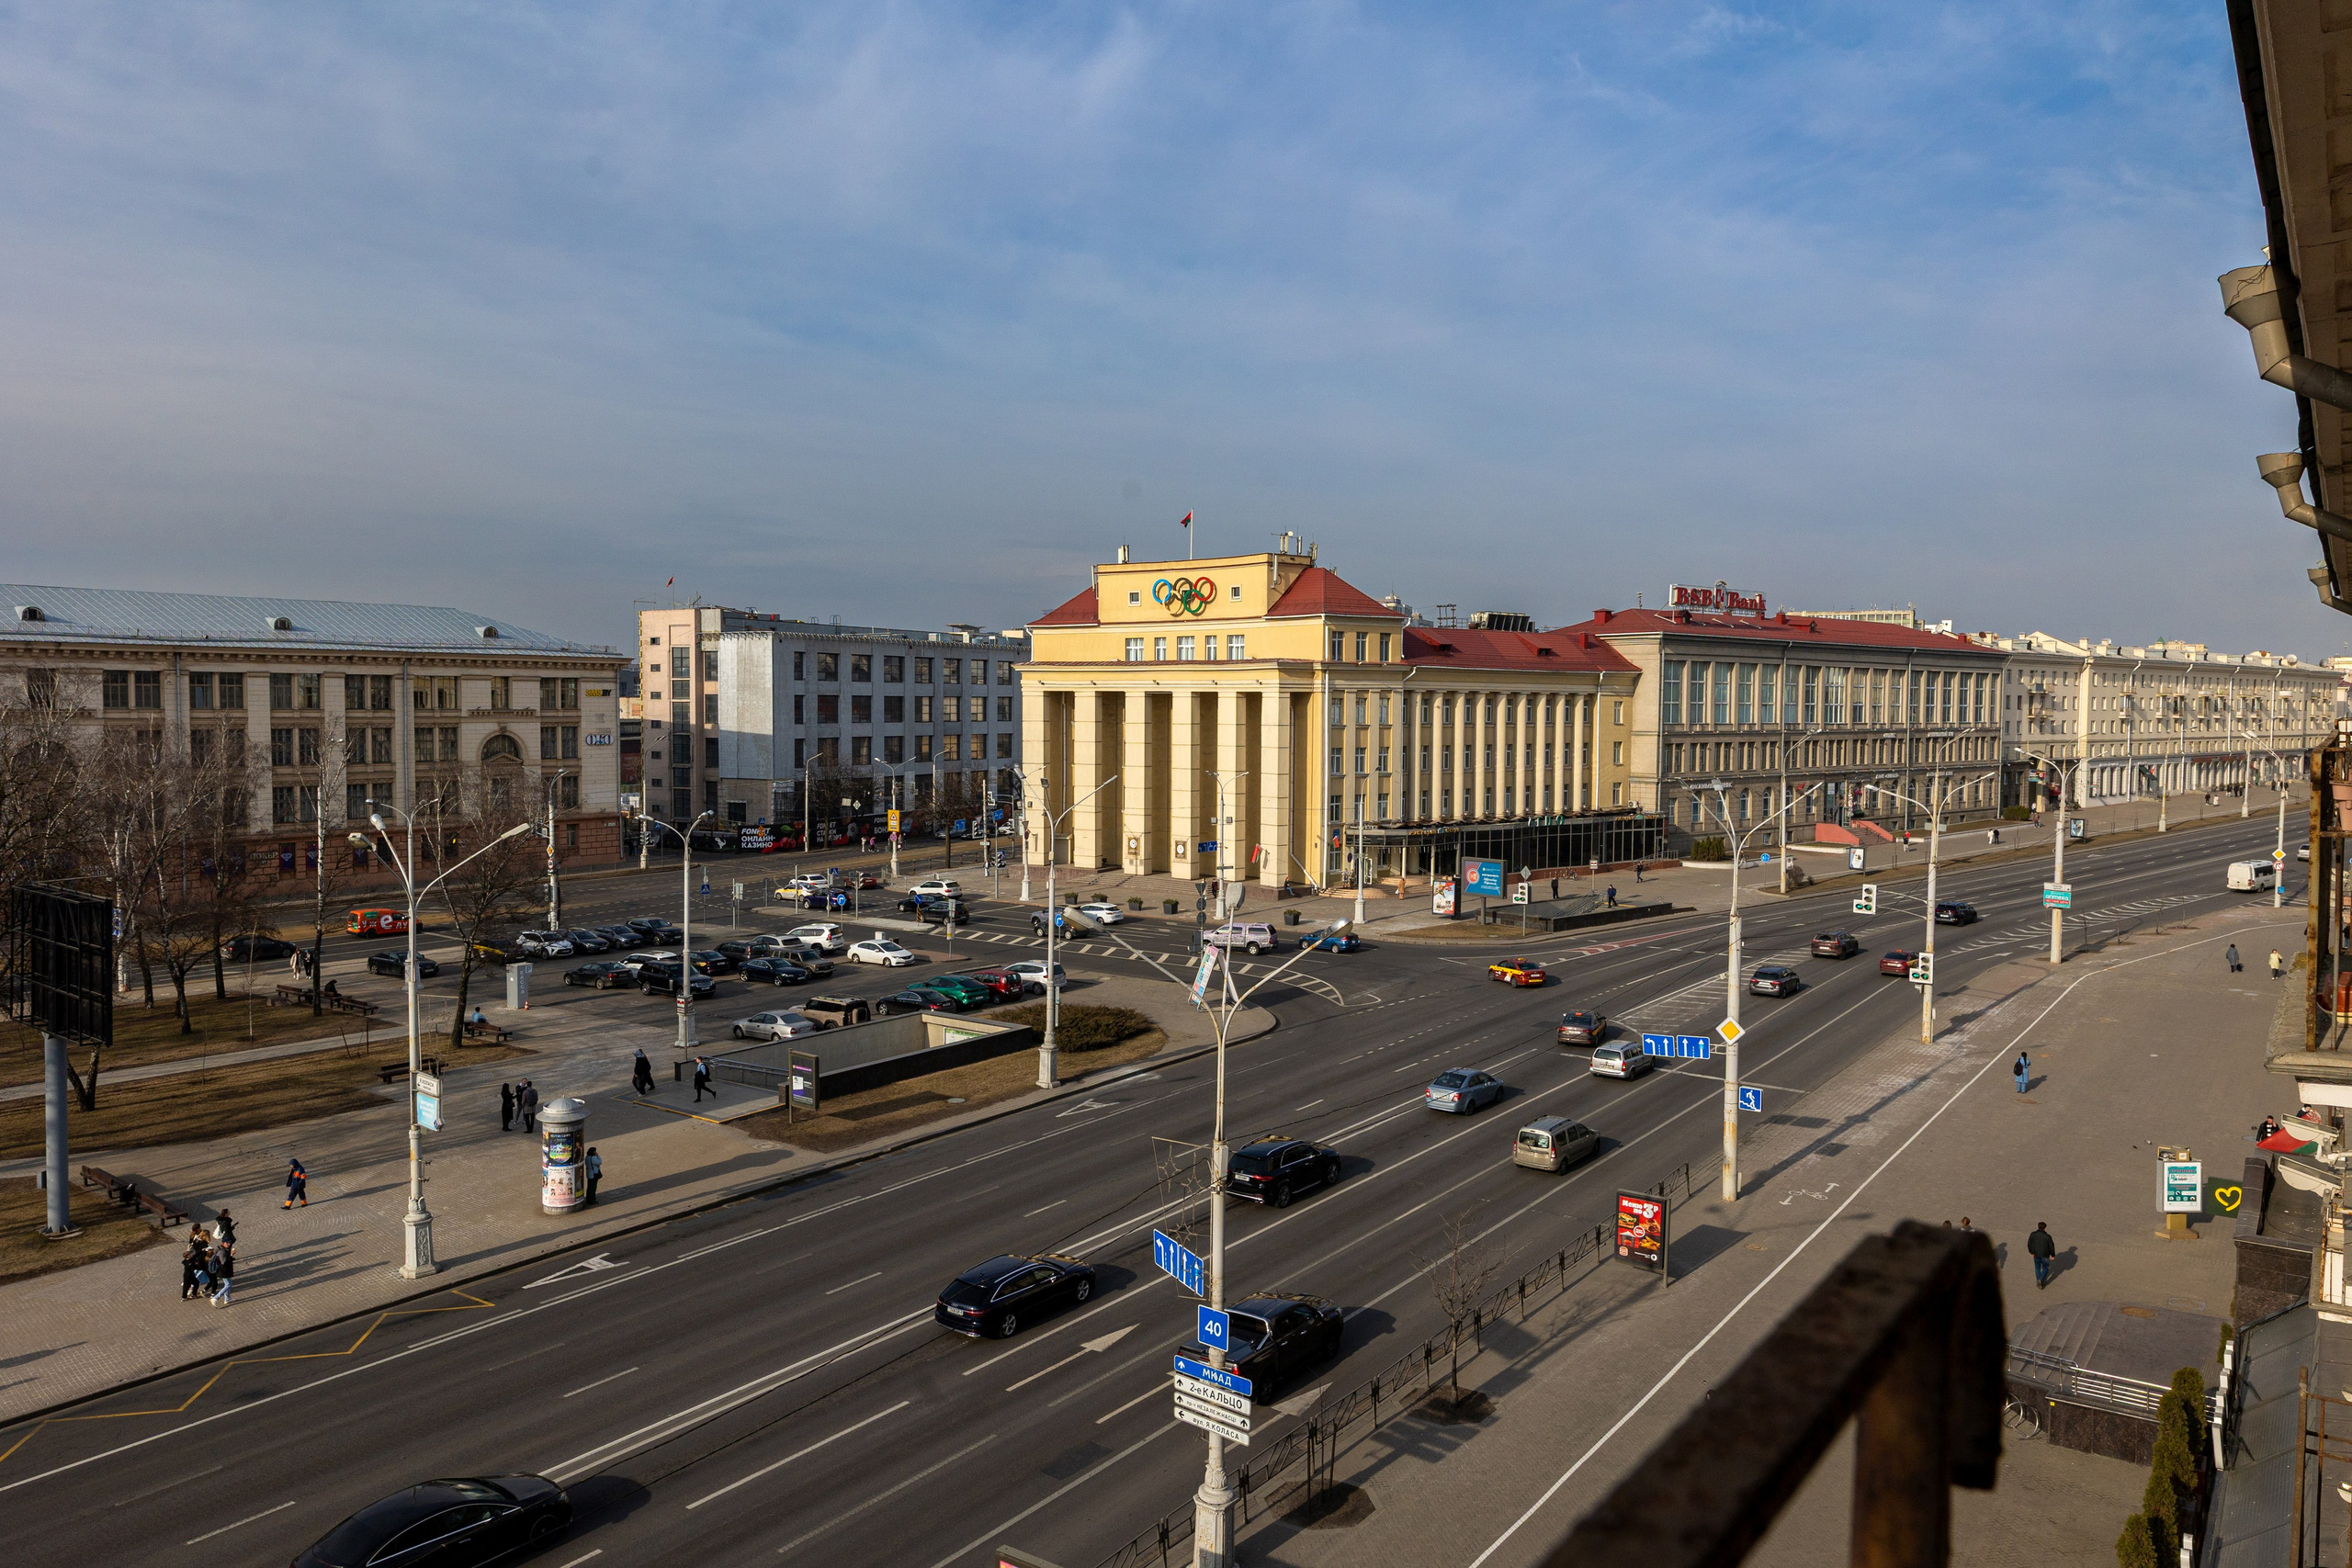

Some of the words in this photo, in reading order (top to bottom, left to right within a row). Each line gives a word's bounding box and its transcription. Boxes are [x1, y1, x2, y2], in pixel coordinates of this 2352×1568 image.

[1674, 586, 1713, 607] BSB
[1726, 591, 1767, 611] Bank
[1622, 1200, 1643, 1210] Меню
[1204, 1320, 1222, 1337] 40
[1203, 1368, 1232, 1387] МКАД
[1203, 1387, 1243, 1409] КАЛЬЦО
[1193, 1417, 1204, 1426] вул.
[1197, 1404, 1237, 1423] НЕЗАЛЕЖНАСЦІ
